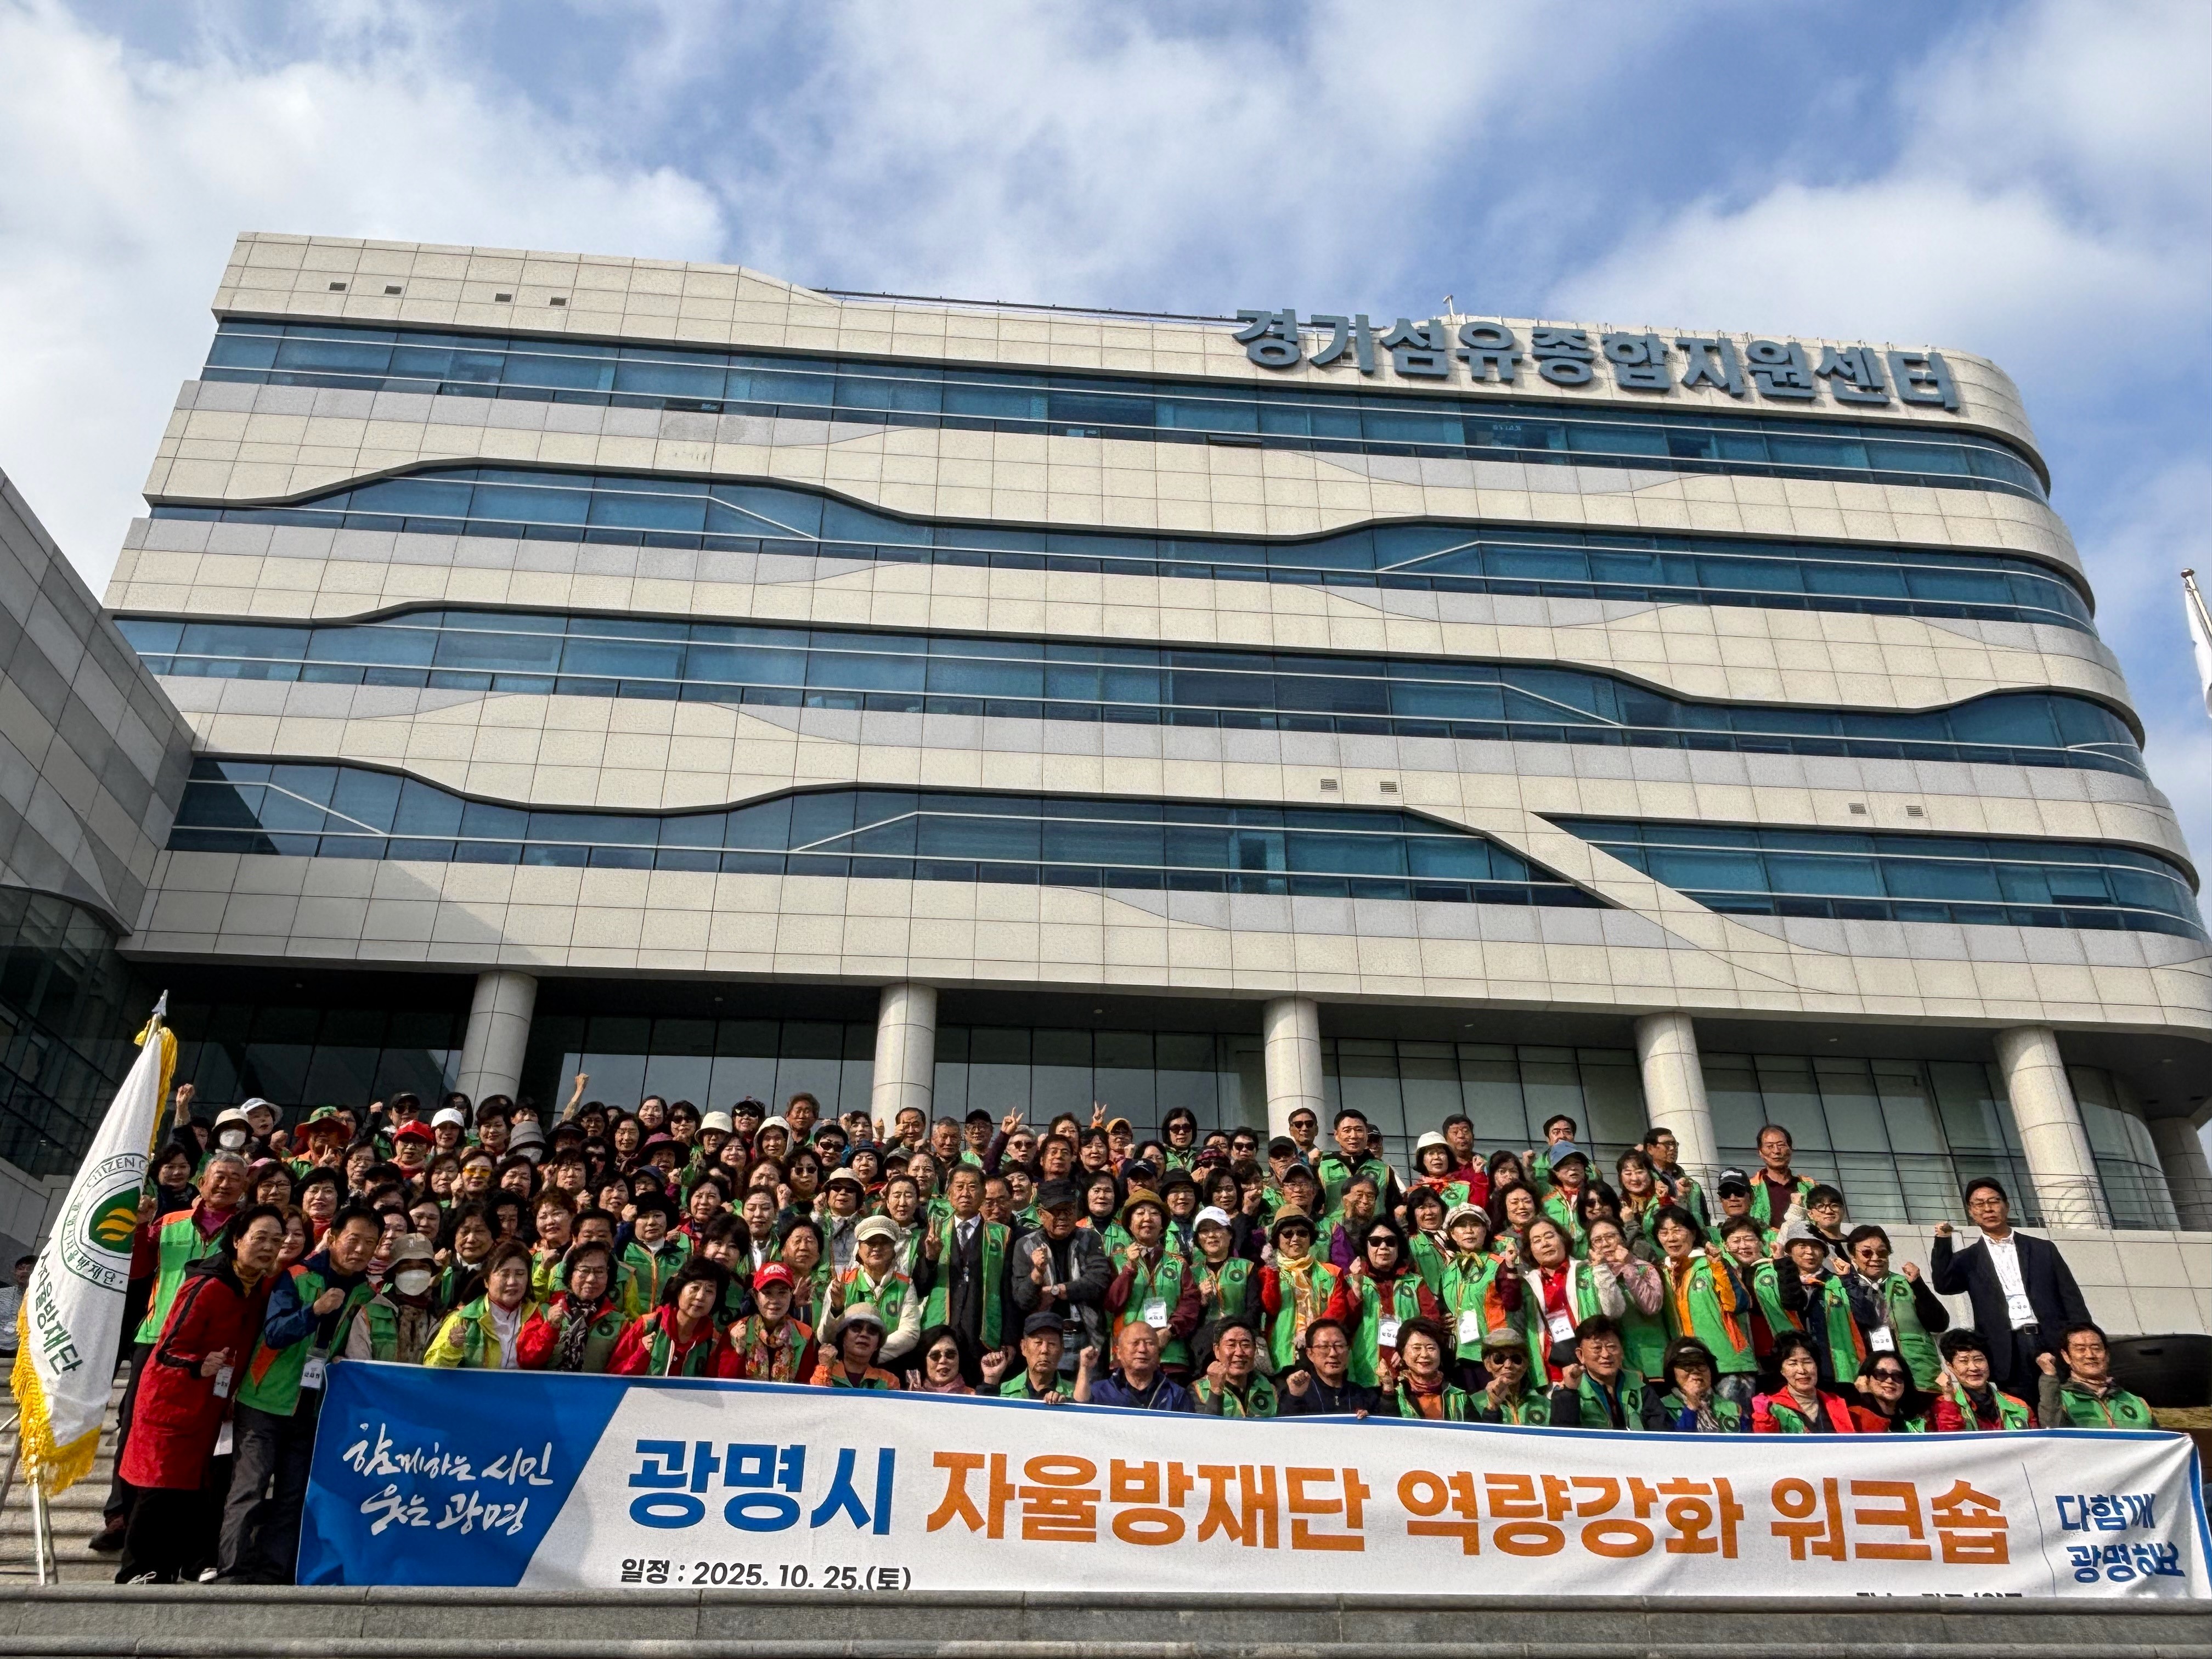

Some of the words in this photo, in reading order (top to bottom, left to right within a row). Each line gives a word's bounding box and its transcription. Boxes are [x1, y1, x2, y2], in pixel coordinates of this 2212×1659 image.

[1232, 308, 1960, 413] 경기섬유종합지원센터
[87, 1156, 135, 1187] CITIZEN
[343, 1423, 476, 1481] 함께하는
[481, 1442, 554, 1485] 시민
[360, 1483, 431, 1536] 웃는
[436, 1490, 528, 1536] 광명
[628, 1440, 896, 1535] 광명시
[927, 1451, 1371, 1551] 자율방재단
[1397, 1470, 1745, 1559] 역량강화
[1770, 1477, 2011, 1565] 워크숍
[2055, 1493, 2156, 1531] 다함께
[621, 1559, 670, 1583] 일정
[691, 1561, 769, 1586] 2025.
[779, 1565, 814, 1588] 10.
